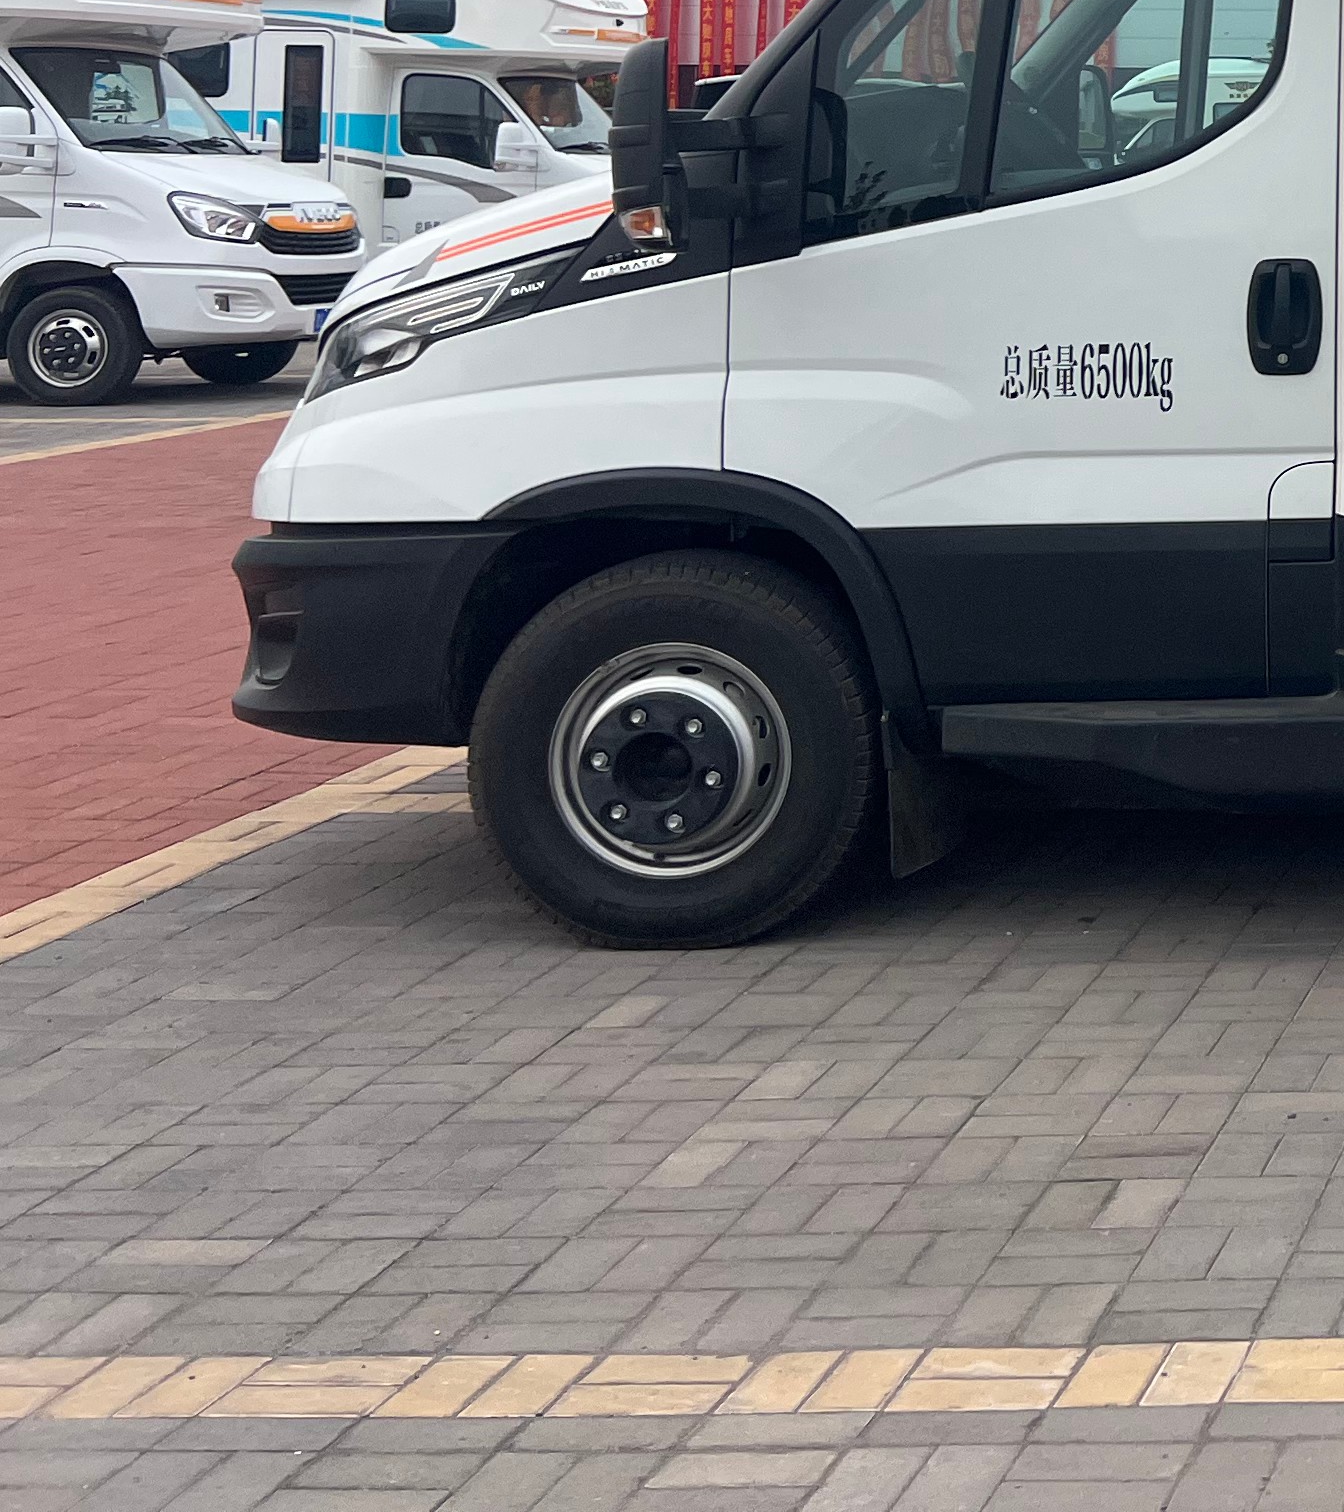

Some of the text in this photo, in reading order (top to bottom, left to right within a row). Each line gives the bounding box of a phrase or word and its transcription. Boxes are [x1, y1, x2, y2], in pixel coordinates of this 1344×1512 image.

[511, 280, 545, 296] DAILY
[1000, 341, 1174, 412] 总质量6500kg
